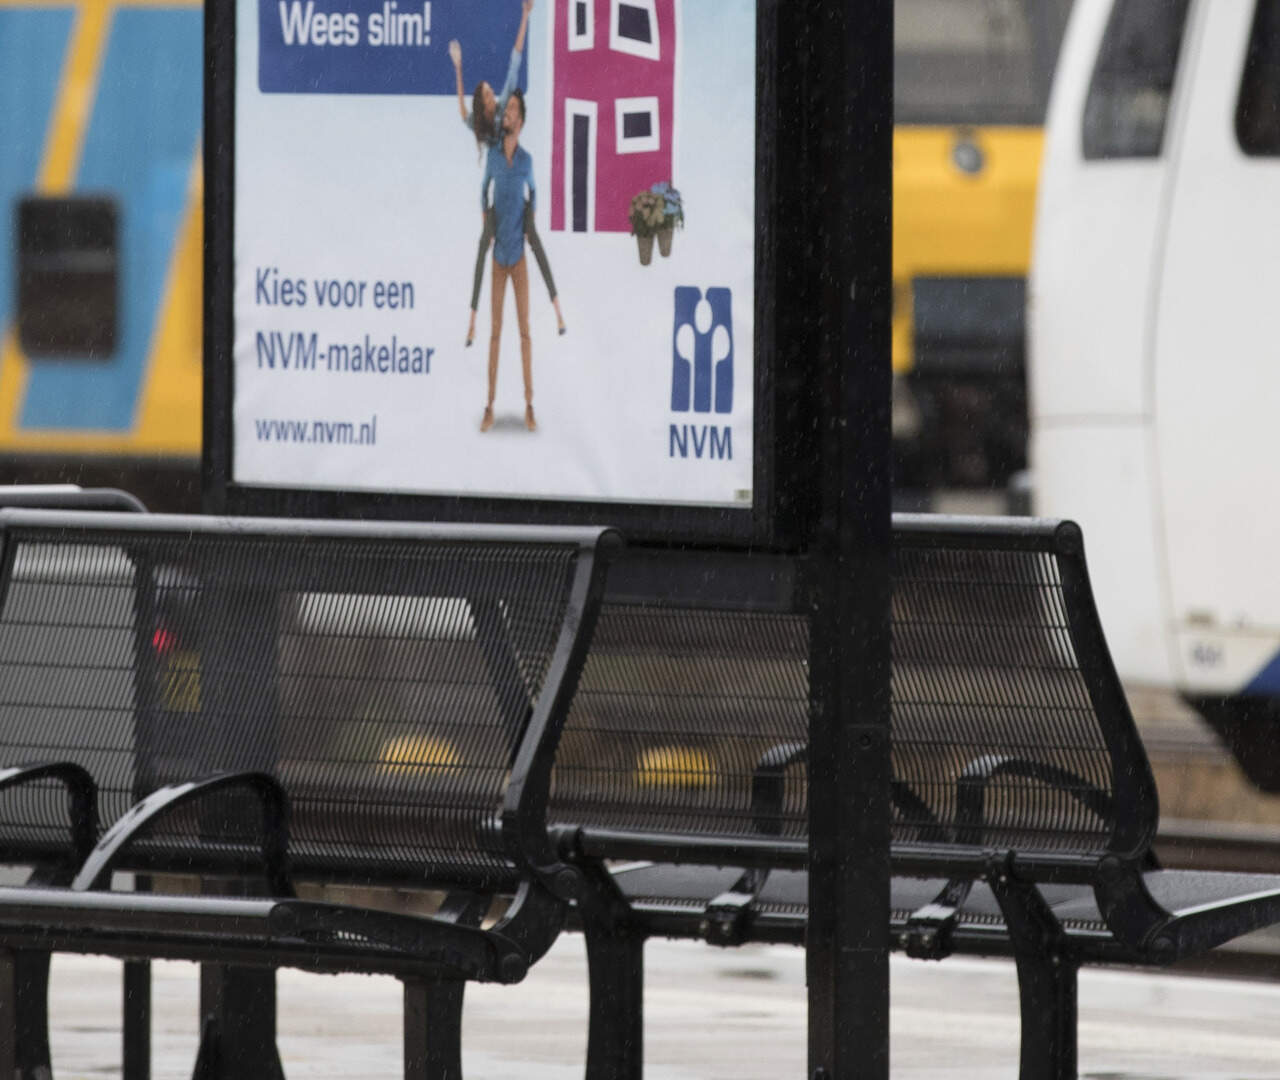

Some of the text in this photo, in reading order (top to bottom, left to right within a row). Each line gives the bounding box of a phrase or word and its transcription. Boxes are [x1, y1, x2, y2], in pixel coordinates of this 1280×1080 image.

[278, 0, 432, 47] Wees slim!
[255, 266, 416, 311] Kies voor een
[254, 329, 436, 376] NVM-makelaar
[254, 414, 378, 446] www.nvm.nl
[668, 422, 734, 462] NVM
